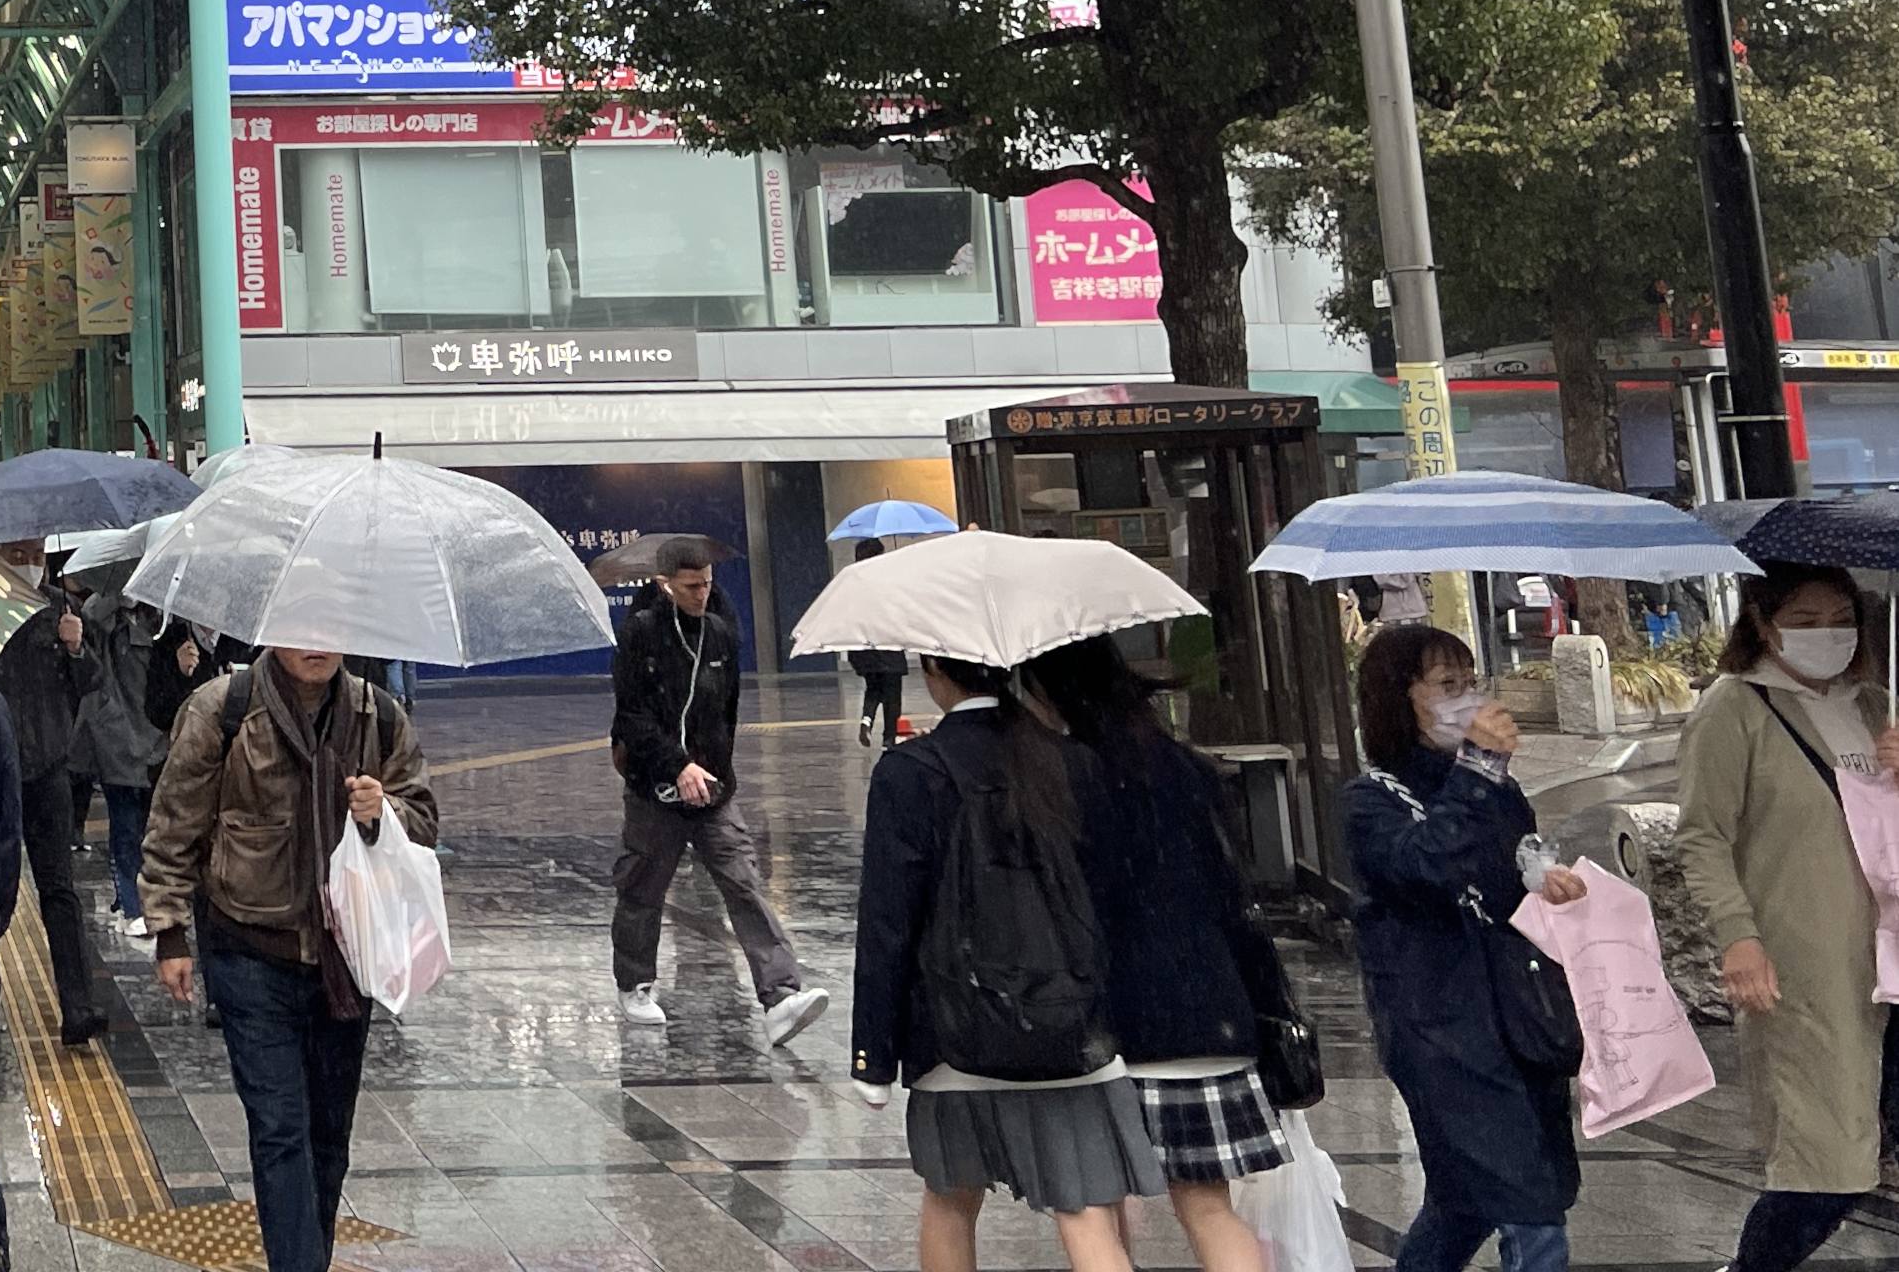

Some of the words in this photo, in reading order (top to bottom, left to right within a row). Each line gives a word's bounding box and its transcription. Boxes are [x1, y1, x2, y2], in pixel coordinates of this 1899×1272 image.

[316, 113, 478, 133] お部屋探しの専門店
[235, 166, 266, 309] Homemate
[327, 173, 348, 278] Homemate
[765, 168, 786, 273] Homemate
[469, 339, 582, 376] 卑弥呼
[589, 348, 673, 363] HIMIKO
